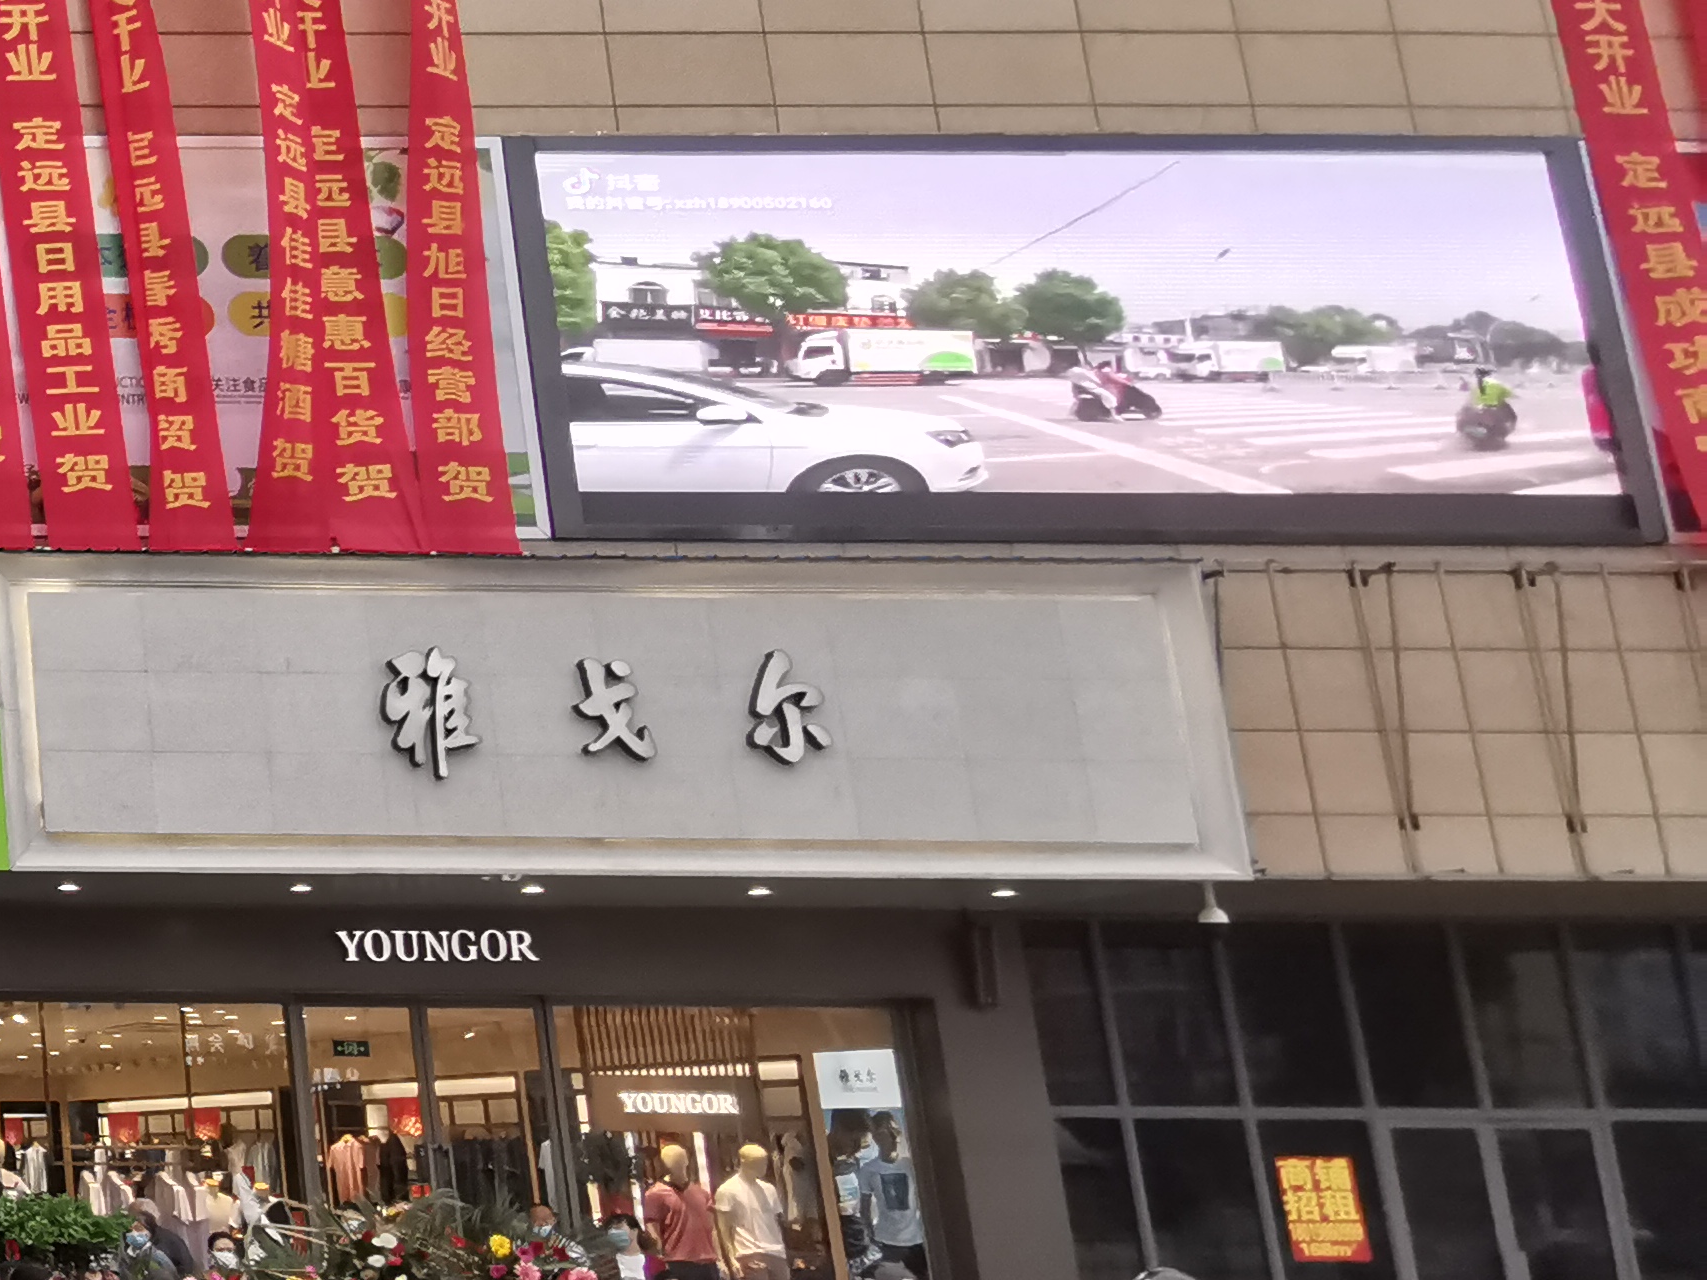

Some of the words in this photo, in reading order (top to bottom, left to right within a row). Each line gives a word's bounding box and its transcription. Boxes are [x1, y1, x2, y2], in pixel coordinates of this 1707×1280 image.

[14, 118, 111, 492] 定远县日用品工业贺
[424, 117, 491, 501] 定远县旭日经营部贺
[380, 645, 833, 780] 雅戈尔
[335, 928, 540, 963] YOUNGOR
[620, 1090, 739, 1115] YOUNGOR
[1283, 1190, 1360, 1221] 招租
